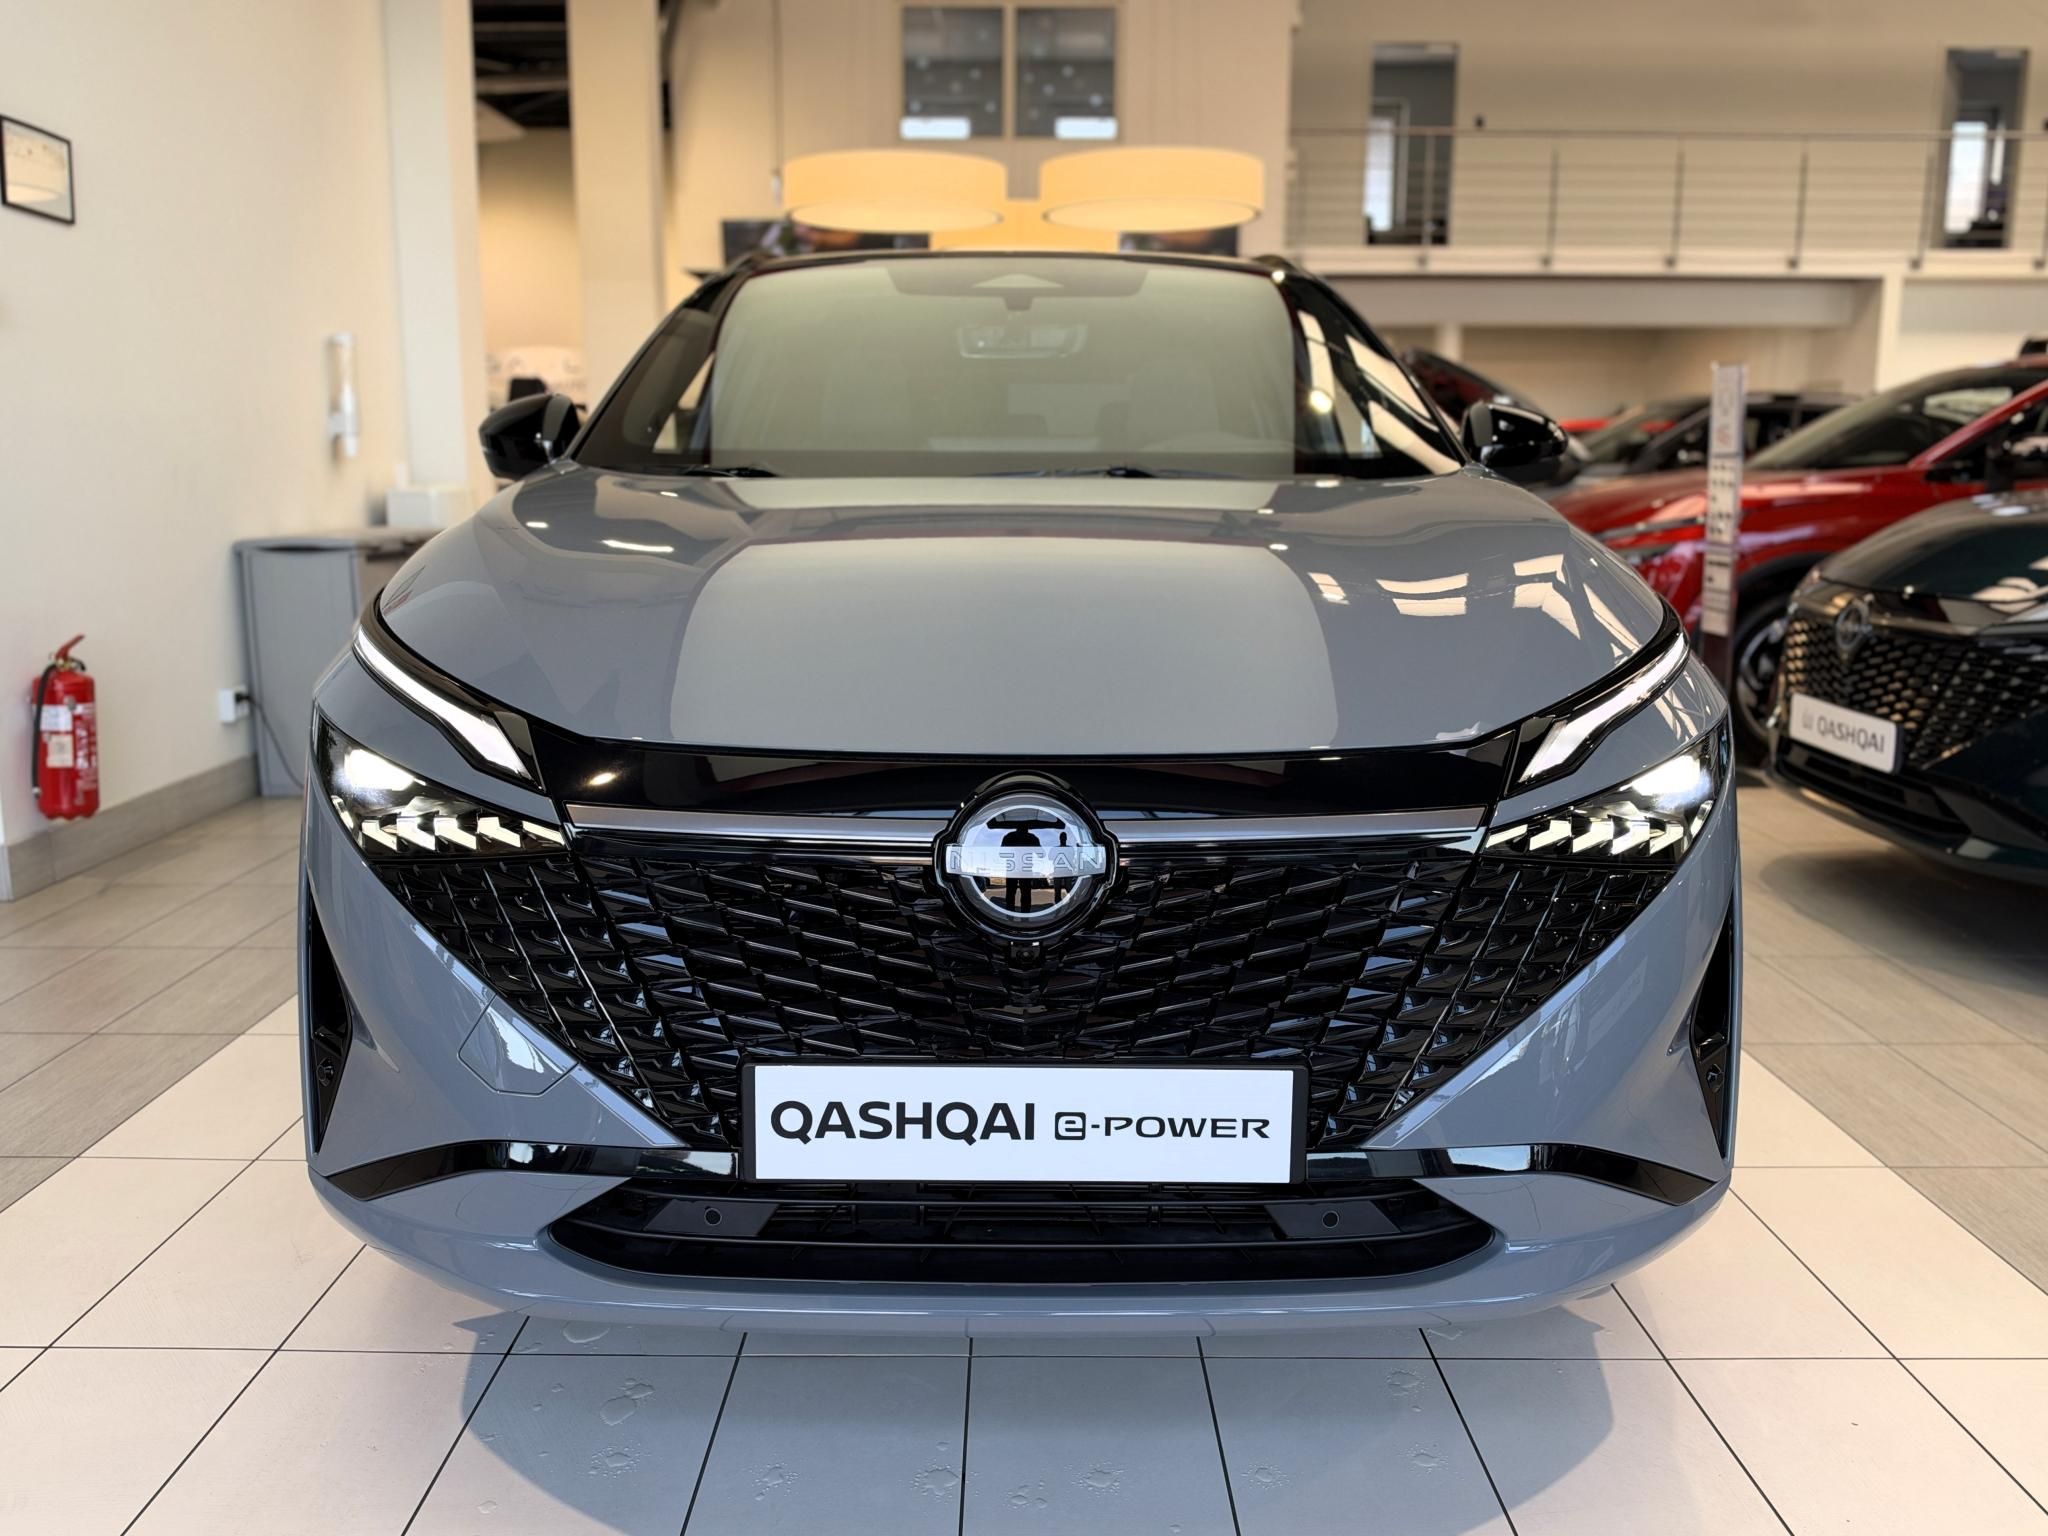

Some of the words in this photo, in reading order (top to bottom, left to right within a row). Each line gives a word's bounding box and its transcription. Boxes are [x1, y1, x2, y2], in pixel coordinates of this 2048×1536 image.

[1817, 714, 1885, 754] QASHQAI
[771, 1101, 1034, 1145] QASHQAI
[1055, 1112, 1269, 1140] e-POWER
